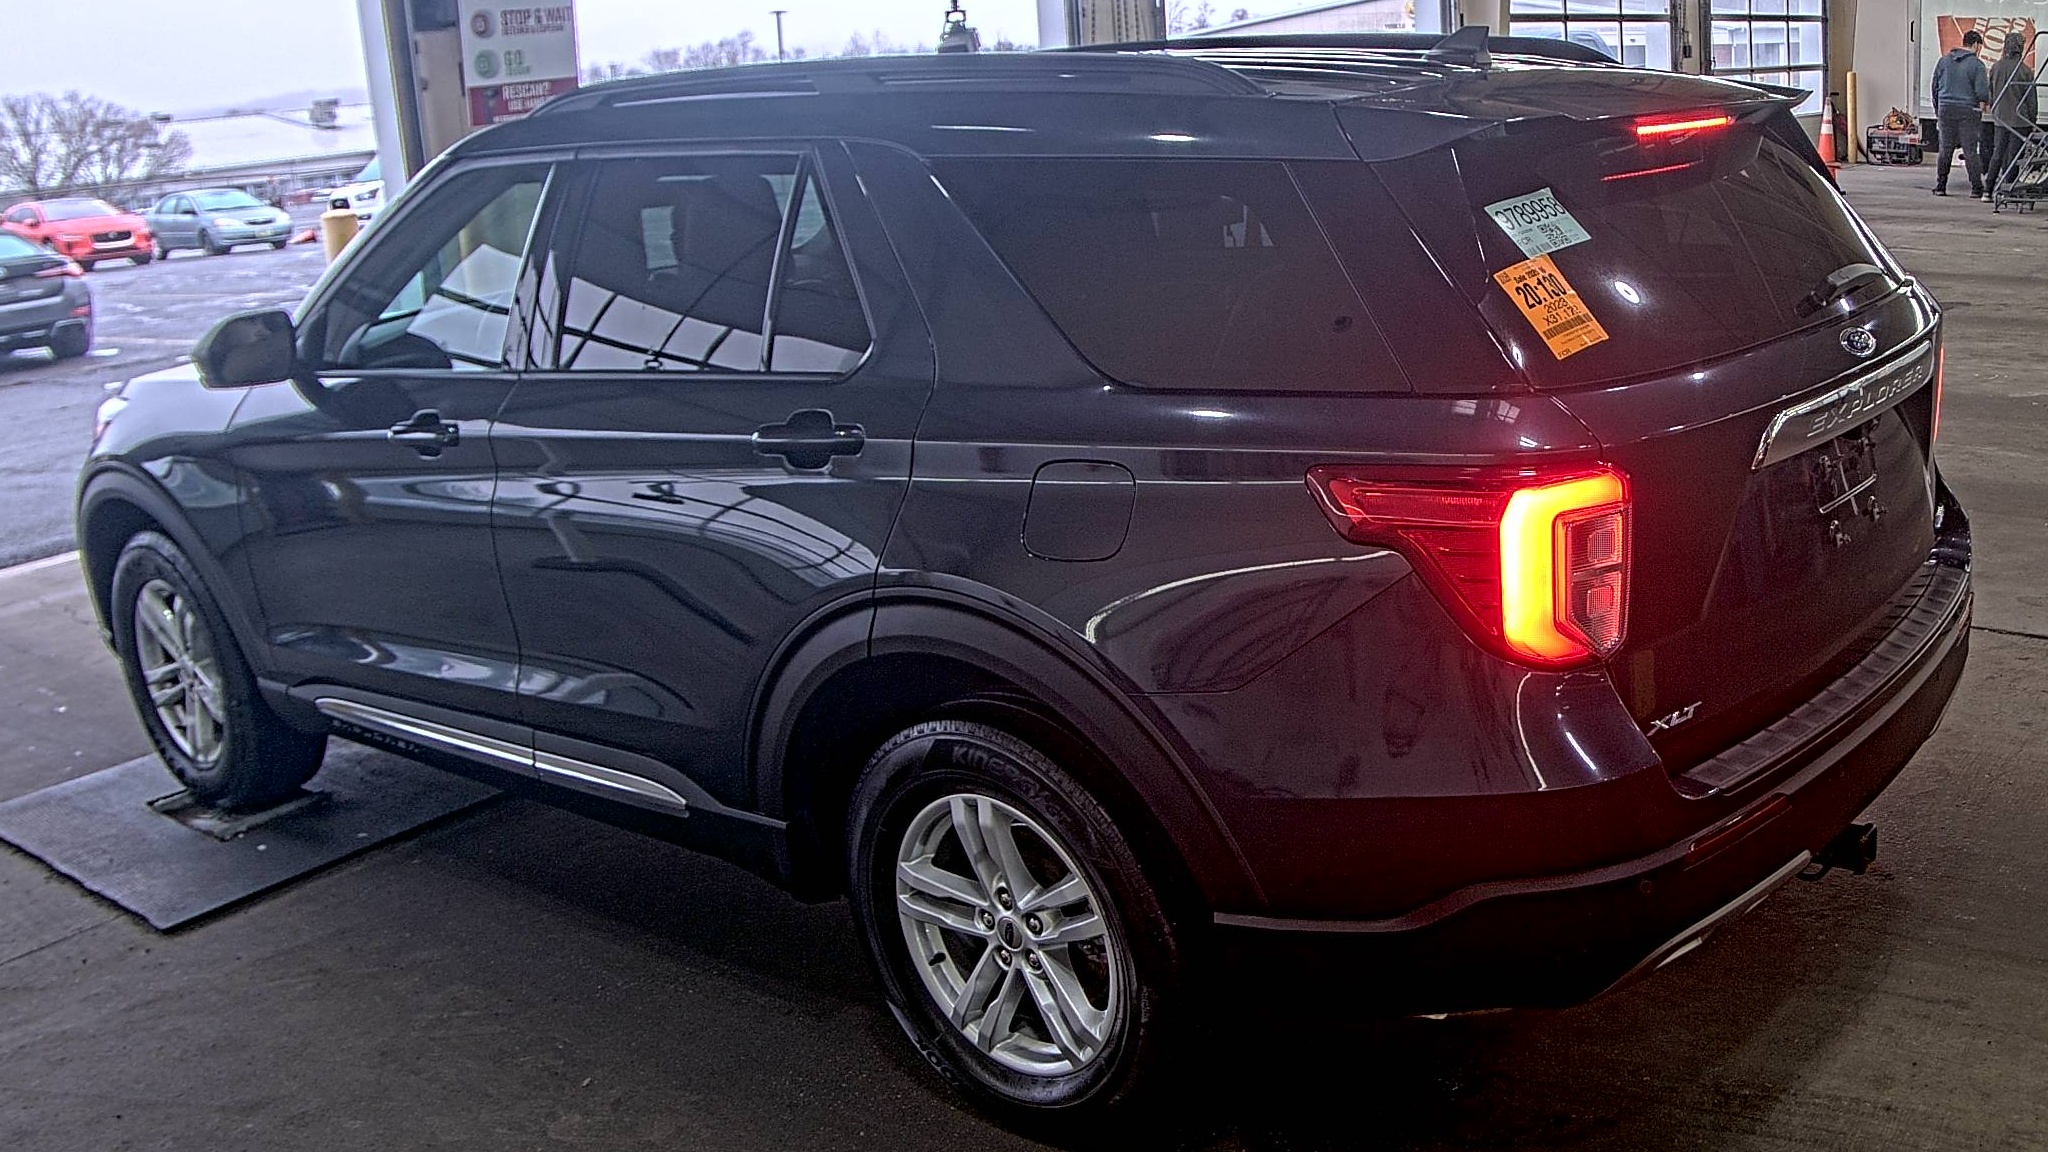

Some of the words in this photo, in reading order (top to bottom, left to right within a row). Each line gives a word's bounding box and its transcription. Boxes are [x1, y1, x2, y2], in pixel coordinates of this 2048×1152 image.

[500, 9, 531, 26] STOP
[544, 6, 572, 23] WAIT
[1494, 196, 1566, 231] 9789958
[1806, 365, 1923, 437] EXPLORER
[1646, 701, 1703, 737] XLT
